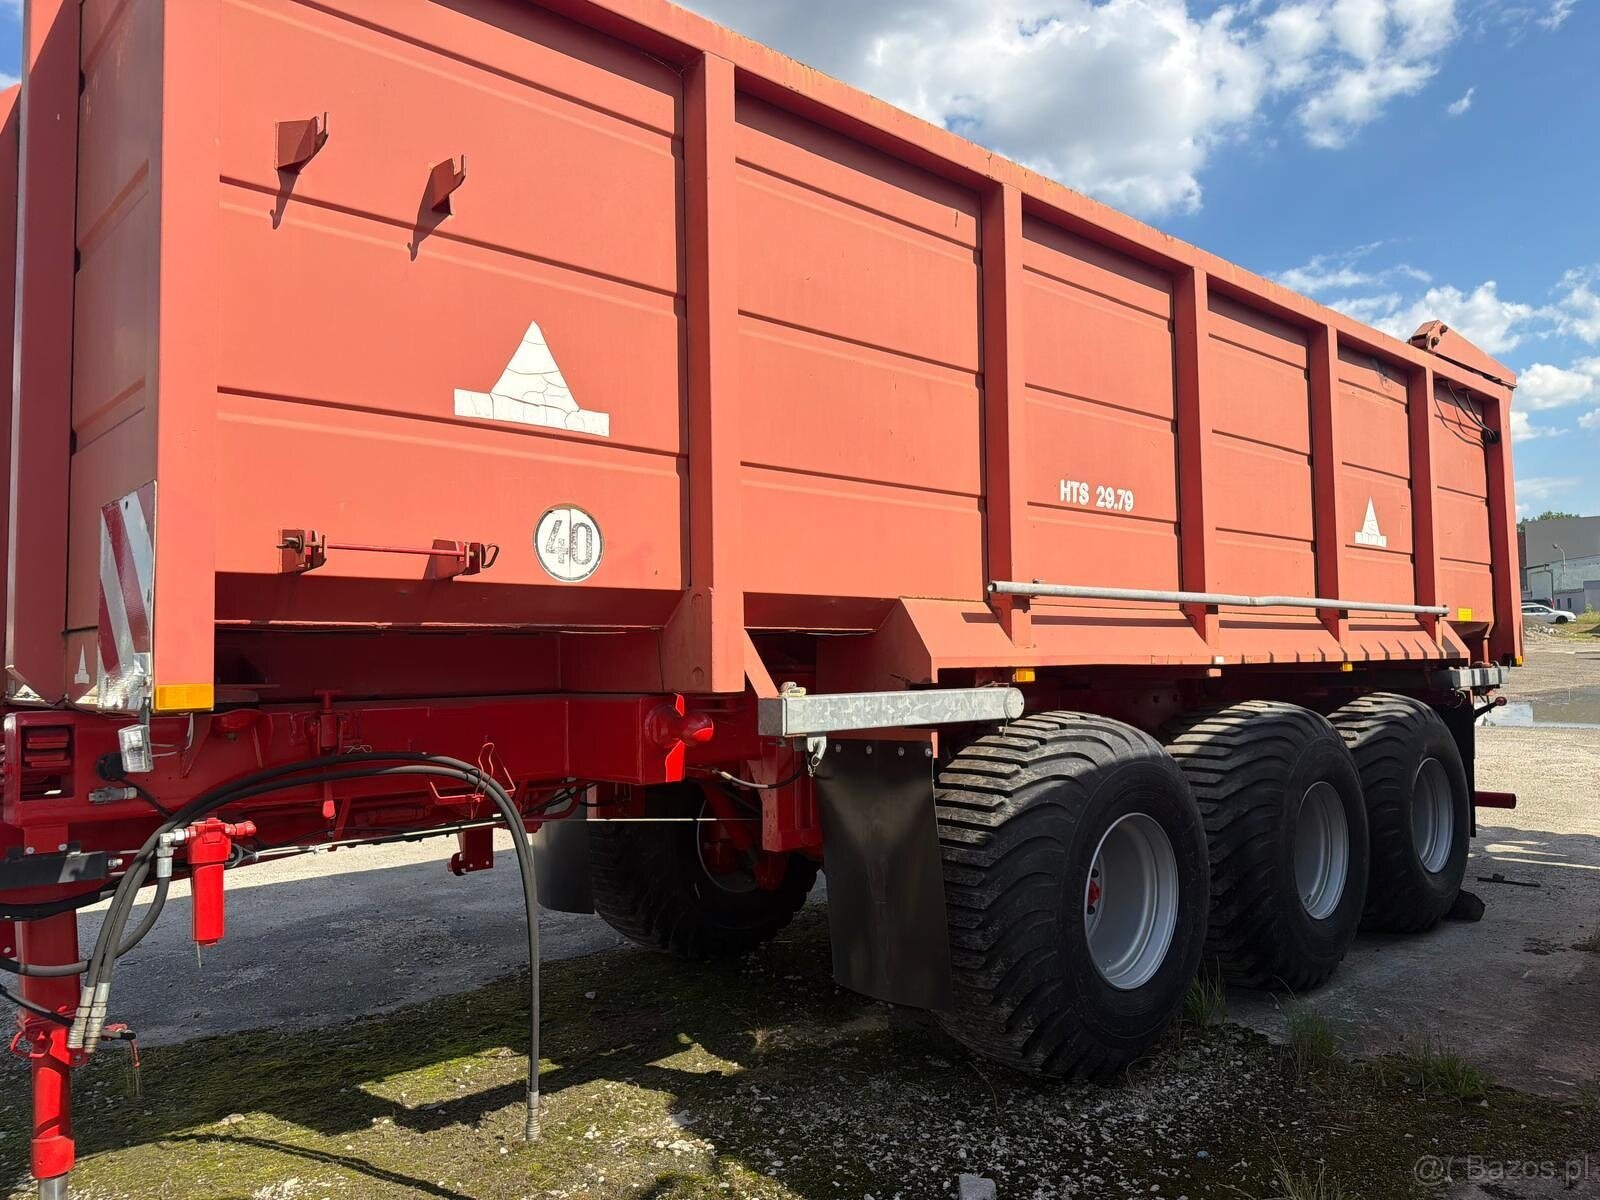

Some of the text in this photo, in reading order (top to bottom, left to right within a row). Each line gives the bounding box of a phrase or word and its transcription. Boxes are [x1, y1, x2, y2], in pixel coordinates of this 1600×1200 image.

[1059, 479, 1134, 512] HTS 29.79
[545, 519, 593, 565] 40
